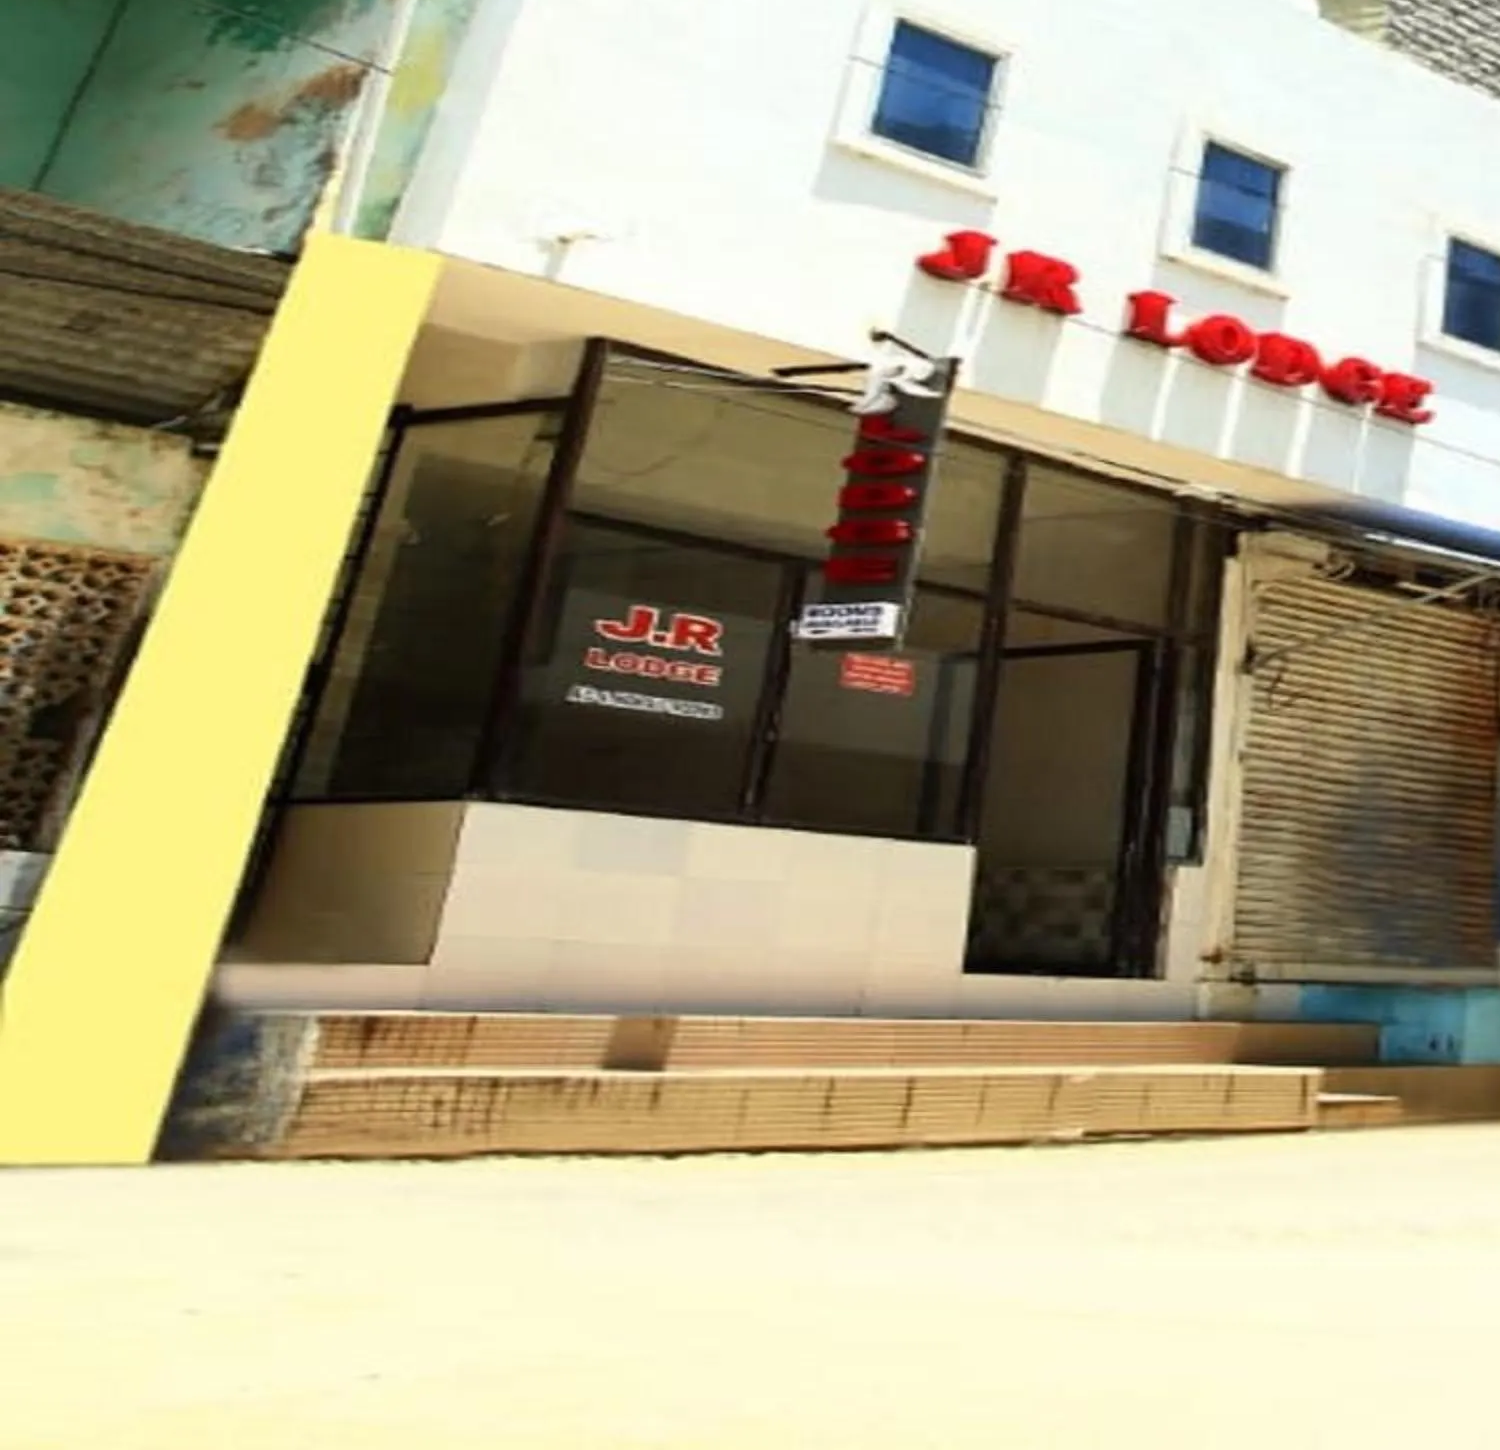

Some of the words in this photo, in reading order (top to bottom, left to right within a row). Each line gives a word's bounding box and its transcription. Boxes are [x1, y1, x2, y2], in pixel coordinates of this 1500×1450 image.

[1121, 289, 1435, 425] LODGE
[594, 605, 724, 658] J.R
[583, 646, 724, 687] LODGE
